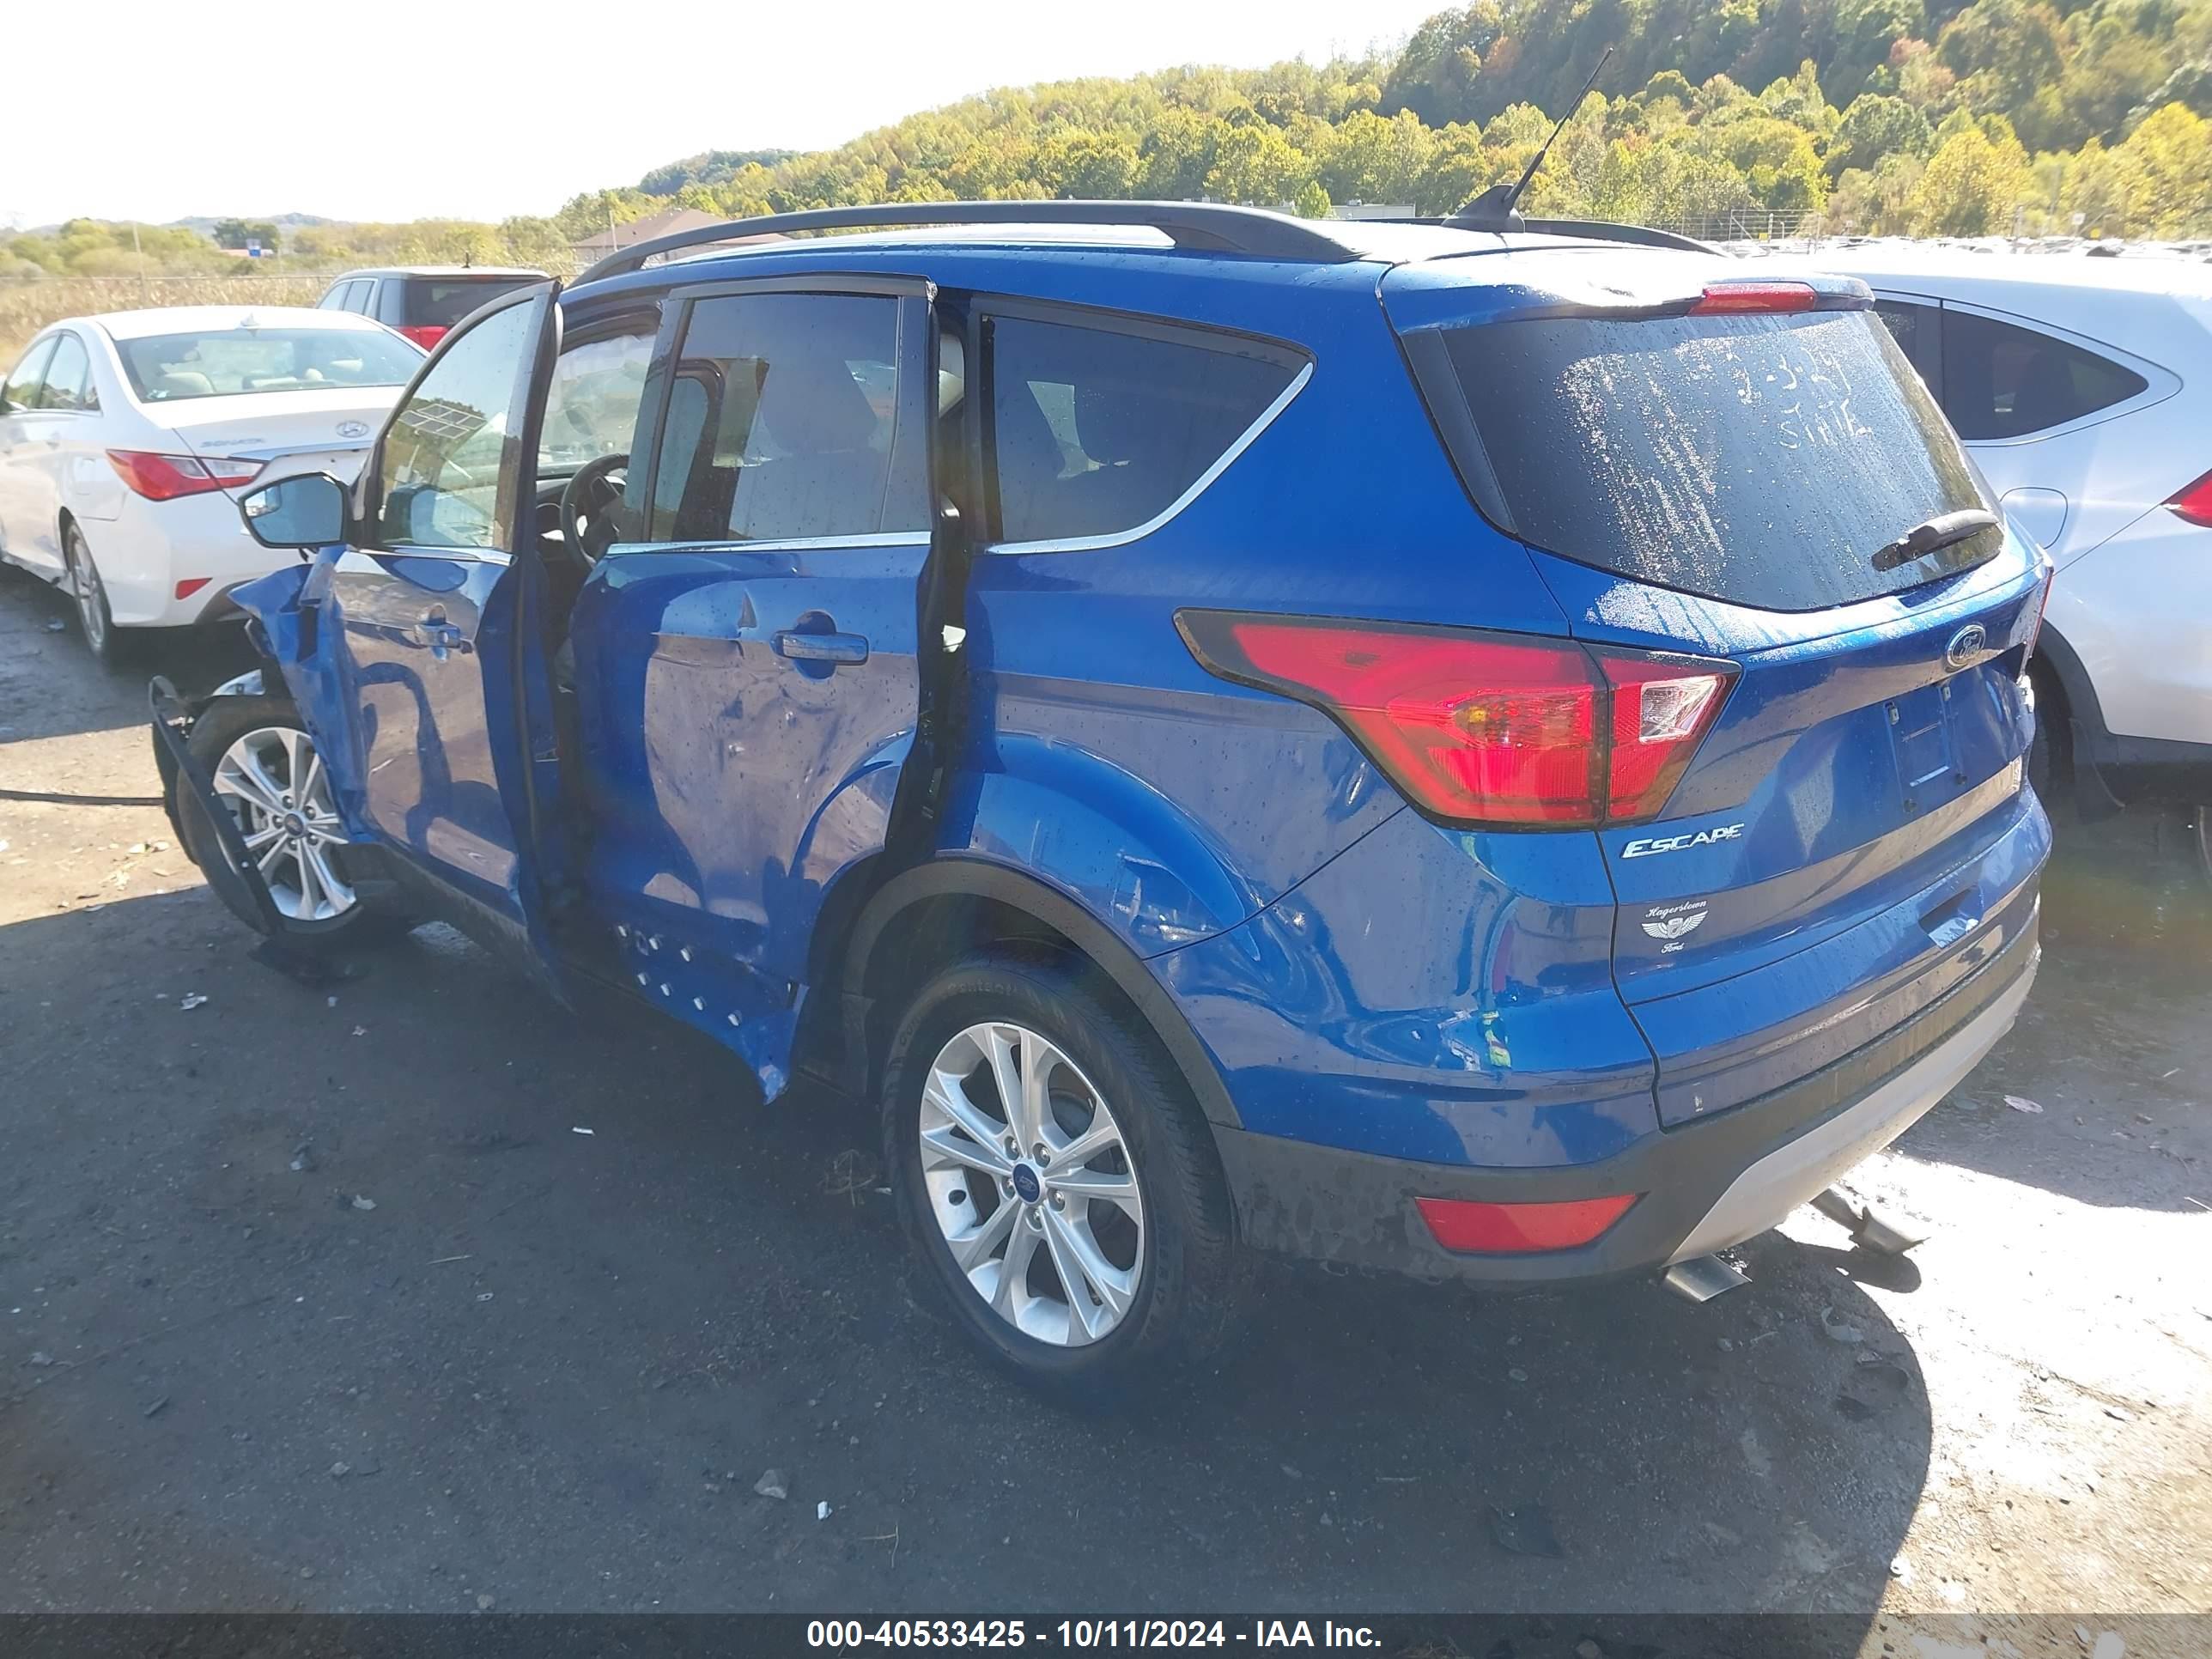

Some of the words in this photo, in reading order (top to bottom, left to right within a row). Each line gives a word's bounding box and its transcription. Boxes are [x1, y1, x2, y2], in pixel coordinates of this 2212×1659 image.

[1621, 823, 1745, 859] ESCAPE
[1645, 900, 1707, 920] Hagerstown
[1661, 941, 1685, 954] Ford
